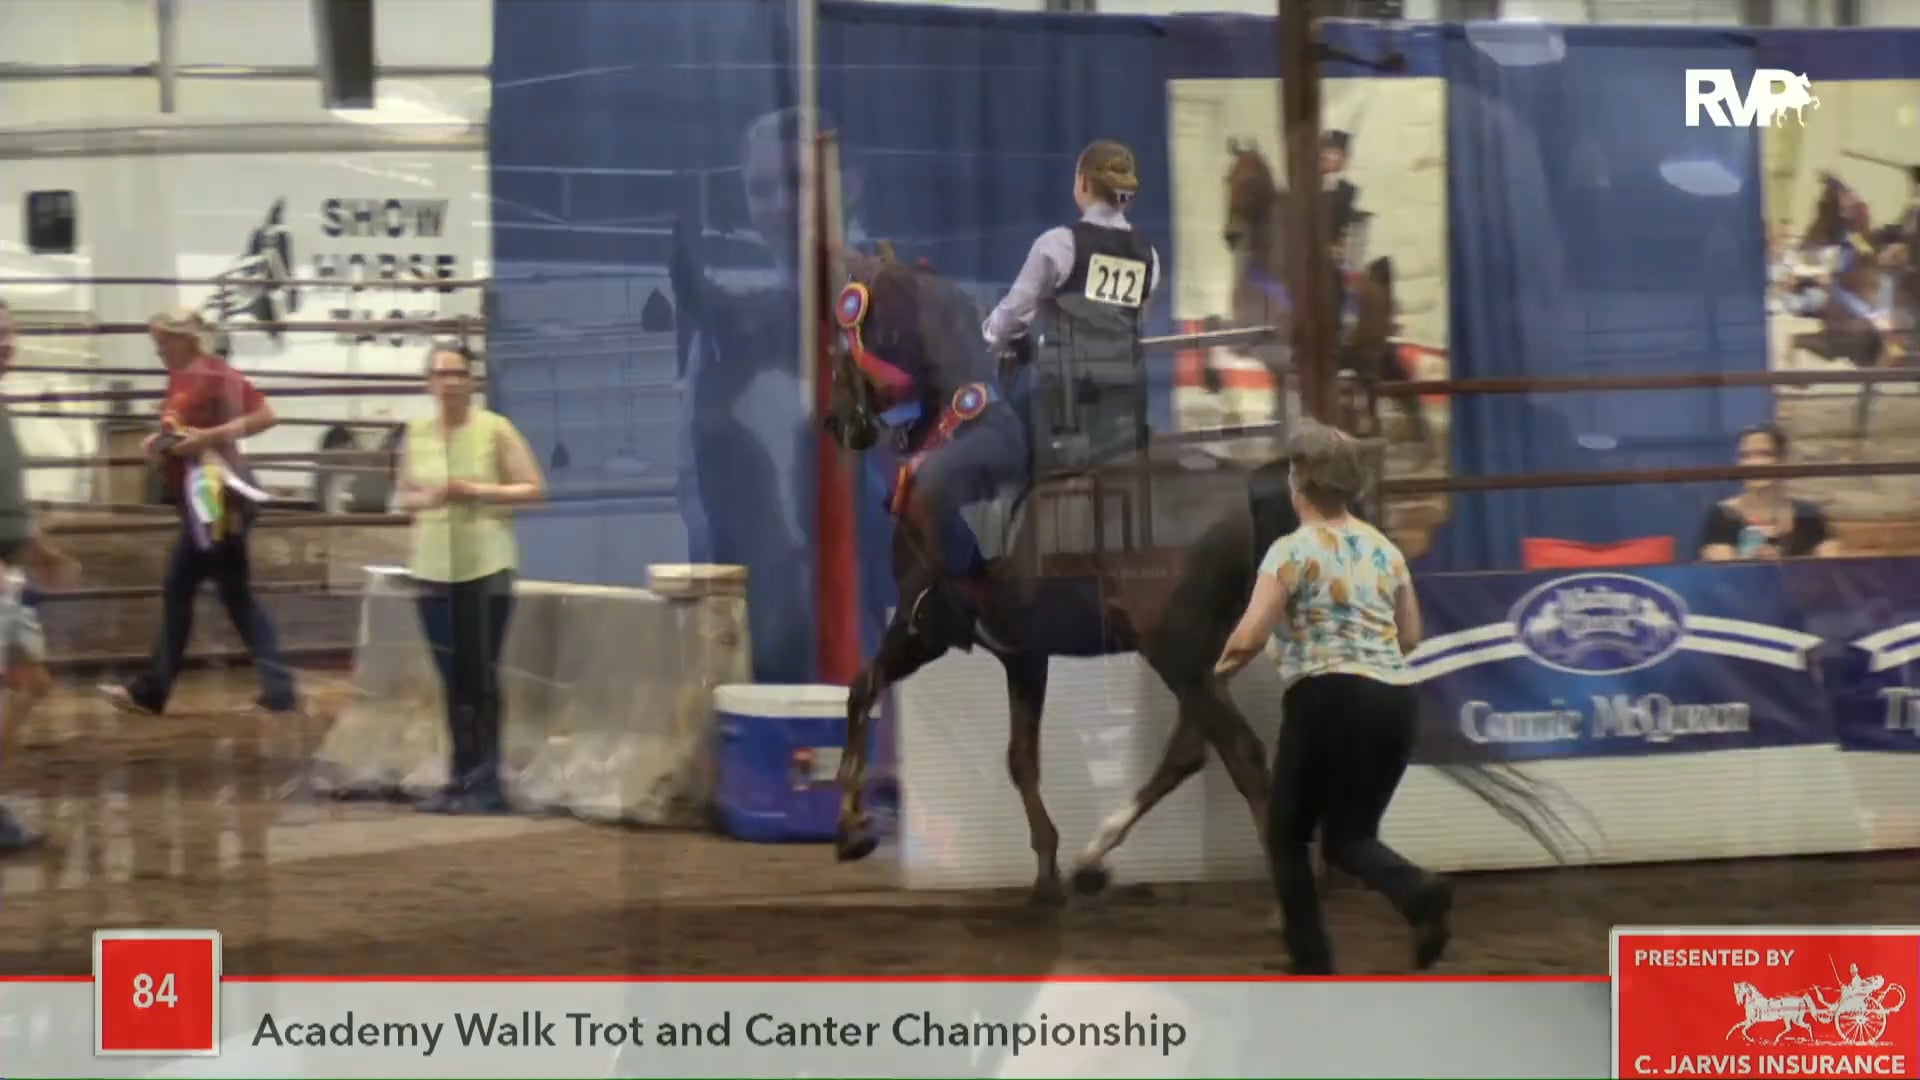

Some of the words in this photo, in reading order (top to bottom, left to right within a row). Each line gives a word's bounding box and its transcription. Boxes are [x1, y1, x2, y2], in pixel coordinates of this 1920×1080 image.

[321, 198, 449, 238] SHOW
[313, 254, 457, 293] HORSE
[1096, 265, 1137, 303] 212
